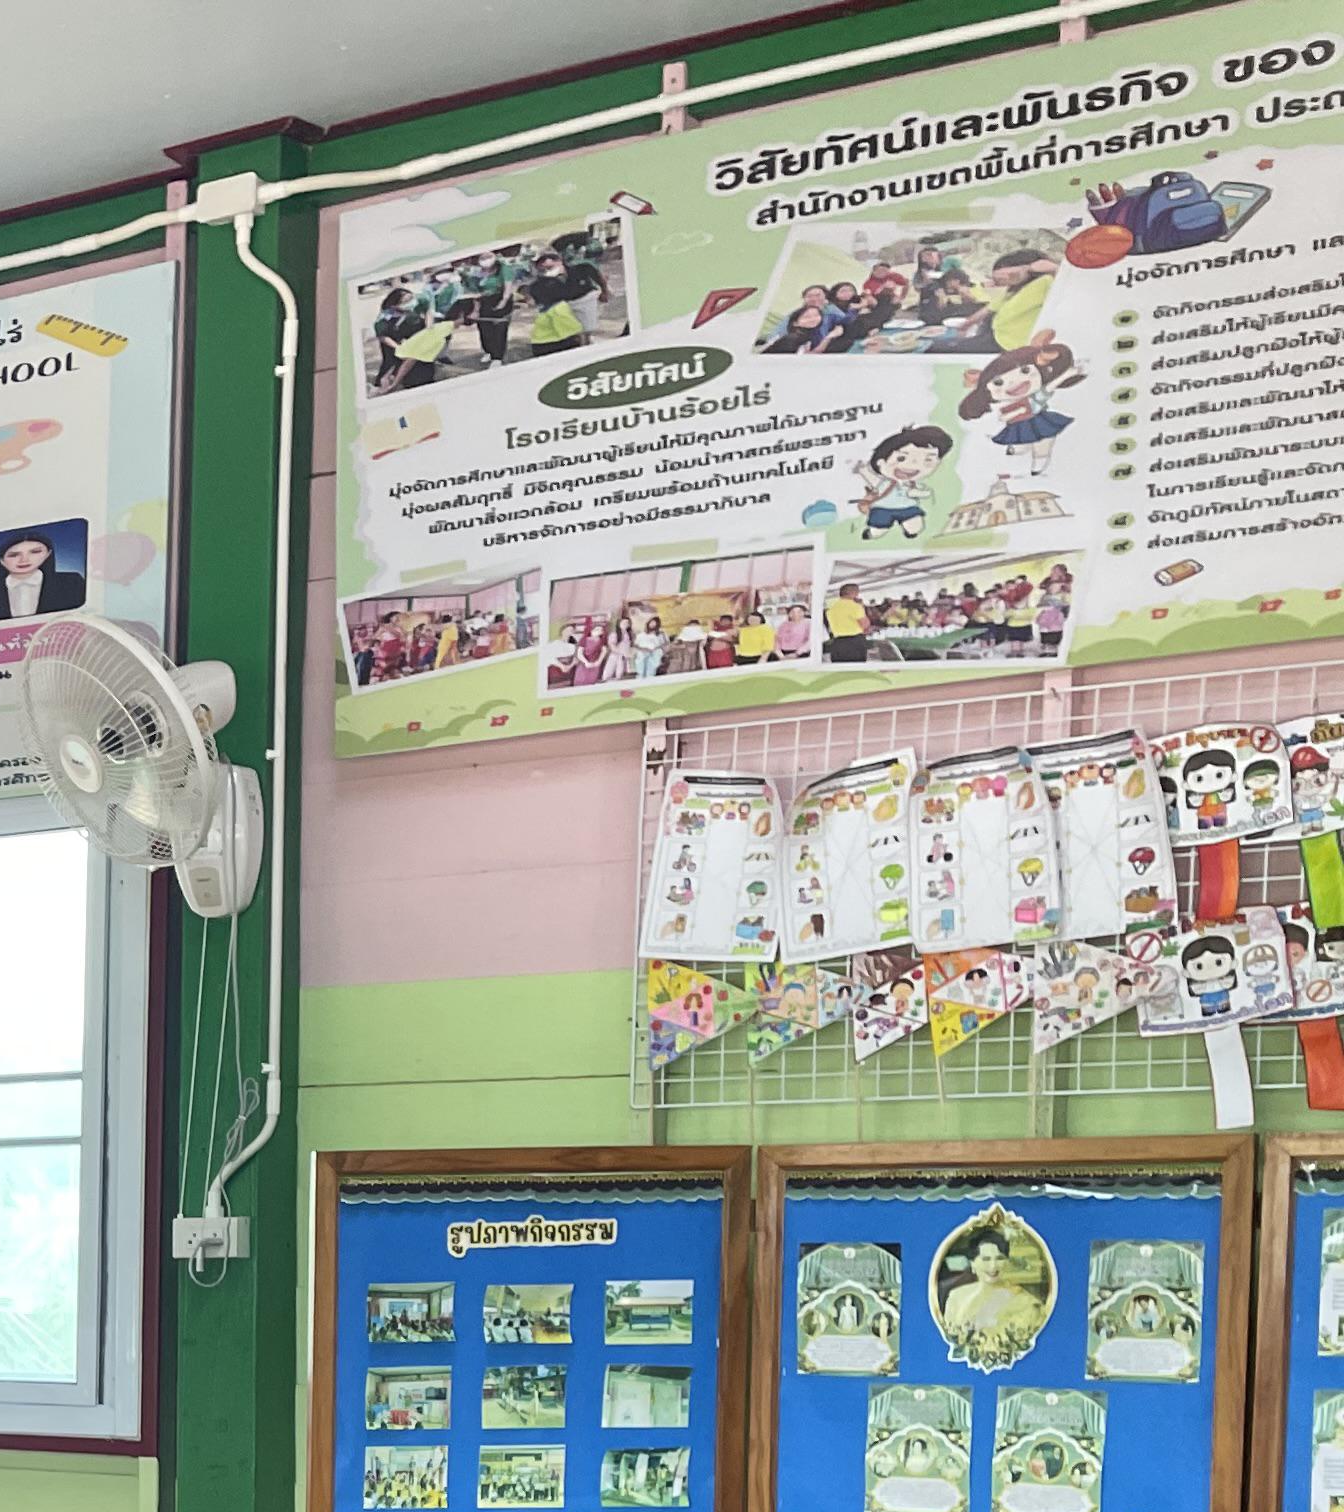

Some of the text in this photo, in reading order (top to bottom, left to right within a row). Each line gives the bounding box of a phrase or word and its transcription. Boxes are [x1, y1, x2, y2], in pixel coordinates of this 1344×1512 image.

[713, 39, 1336, 192] วิสัยทัศน์และพันธกิจ ของ
[755, 113, 1230, 227] สำนักงานเขตพื้นที่การศึกษา
[1151, 327, 1344, 371] ส่งเสริมปลูกฝังให้ผู้
[566, 352, 708, 401] วิสัยทัศน์
[505, 382, 772, 450] โรงเรียนบ้านร้อยไร่
[1150, 409, 1344, 447] ส่งเสริมและพัฒนาส
[1149, 436, 1344, 473] ส่งเสริมพัฒนาระบบ
[450, 1217, 615, 1255] รูปภาพกิจกรรม
